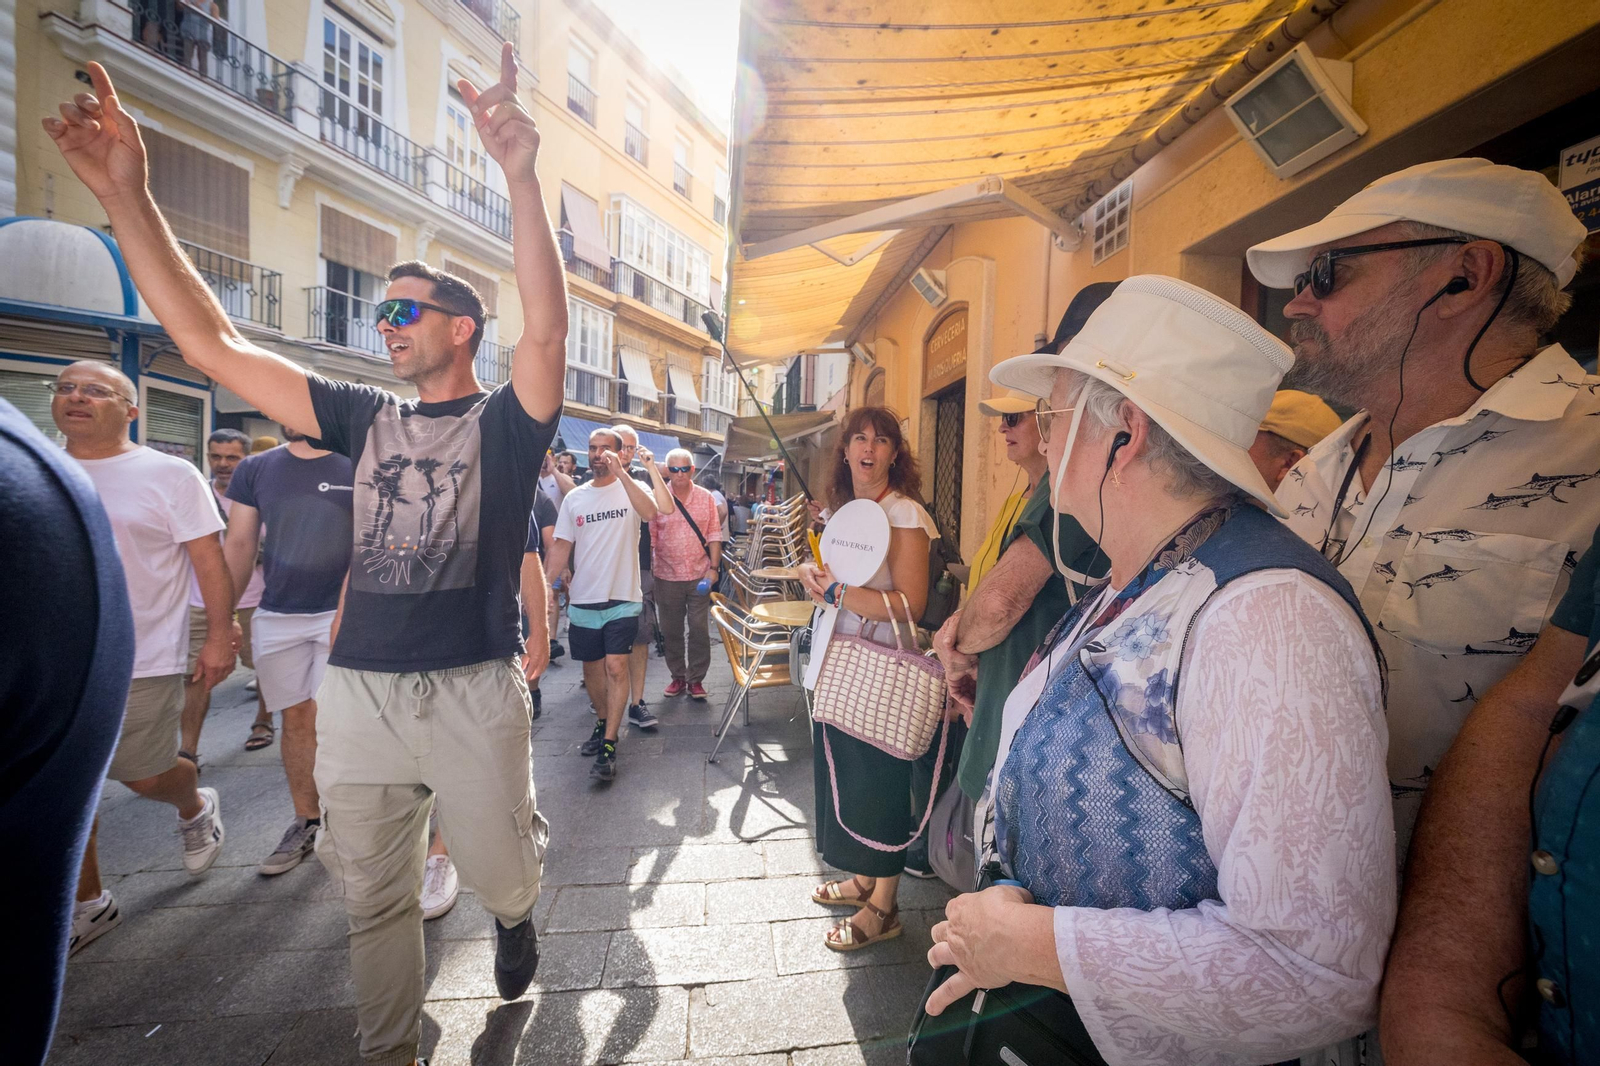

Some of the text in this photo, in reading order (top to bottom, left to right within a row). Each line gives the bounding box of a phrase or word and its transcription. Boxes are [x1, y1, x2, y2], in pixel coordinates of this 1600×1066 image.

[586, 508, 628, 524] ELEMENT
[836, 540, 874, 552] SILVERSEA
[417, 538, 455, 577] EST
